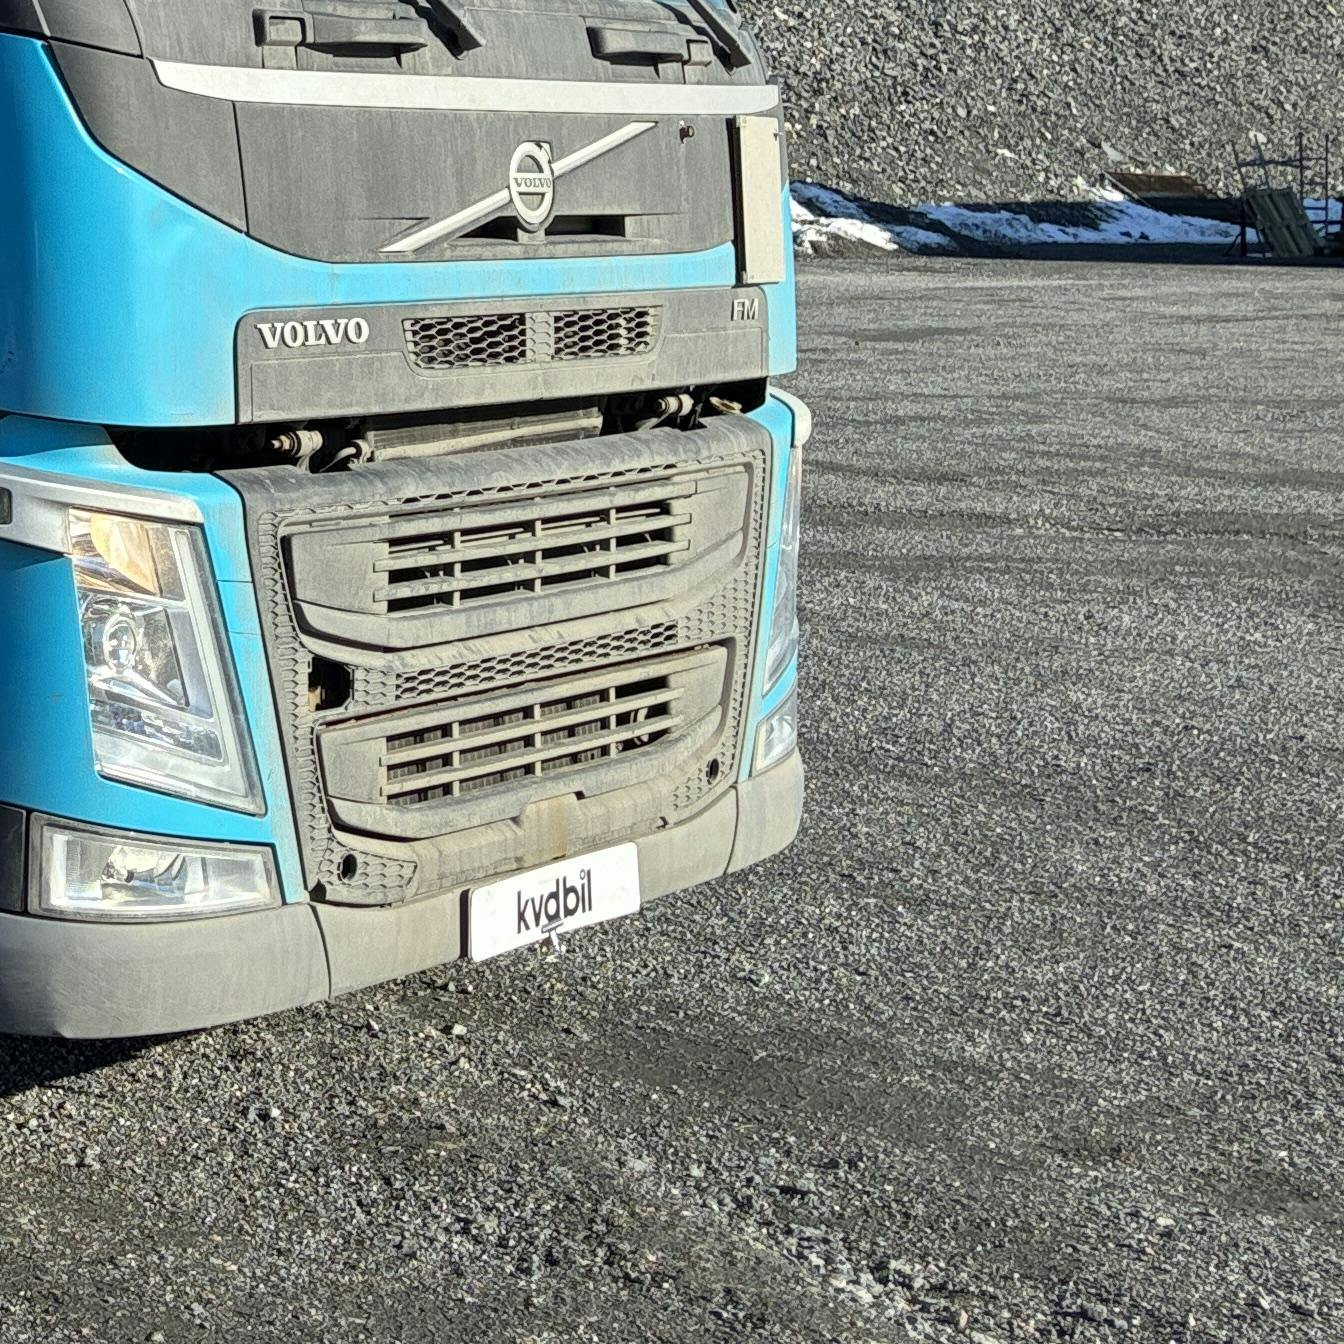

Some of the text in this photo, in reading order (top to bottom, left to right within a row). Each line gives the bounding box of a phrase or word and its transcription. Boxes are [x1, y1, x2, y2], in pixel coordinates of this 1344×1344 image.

[512, 177, 551, 188] VOLVO
[732, 297, 759, 321] FM
[254, 317, 369, 349] VOLVO
[516, 868, 593, 935] kvdbil
